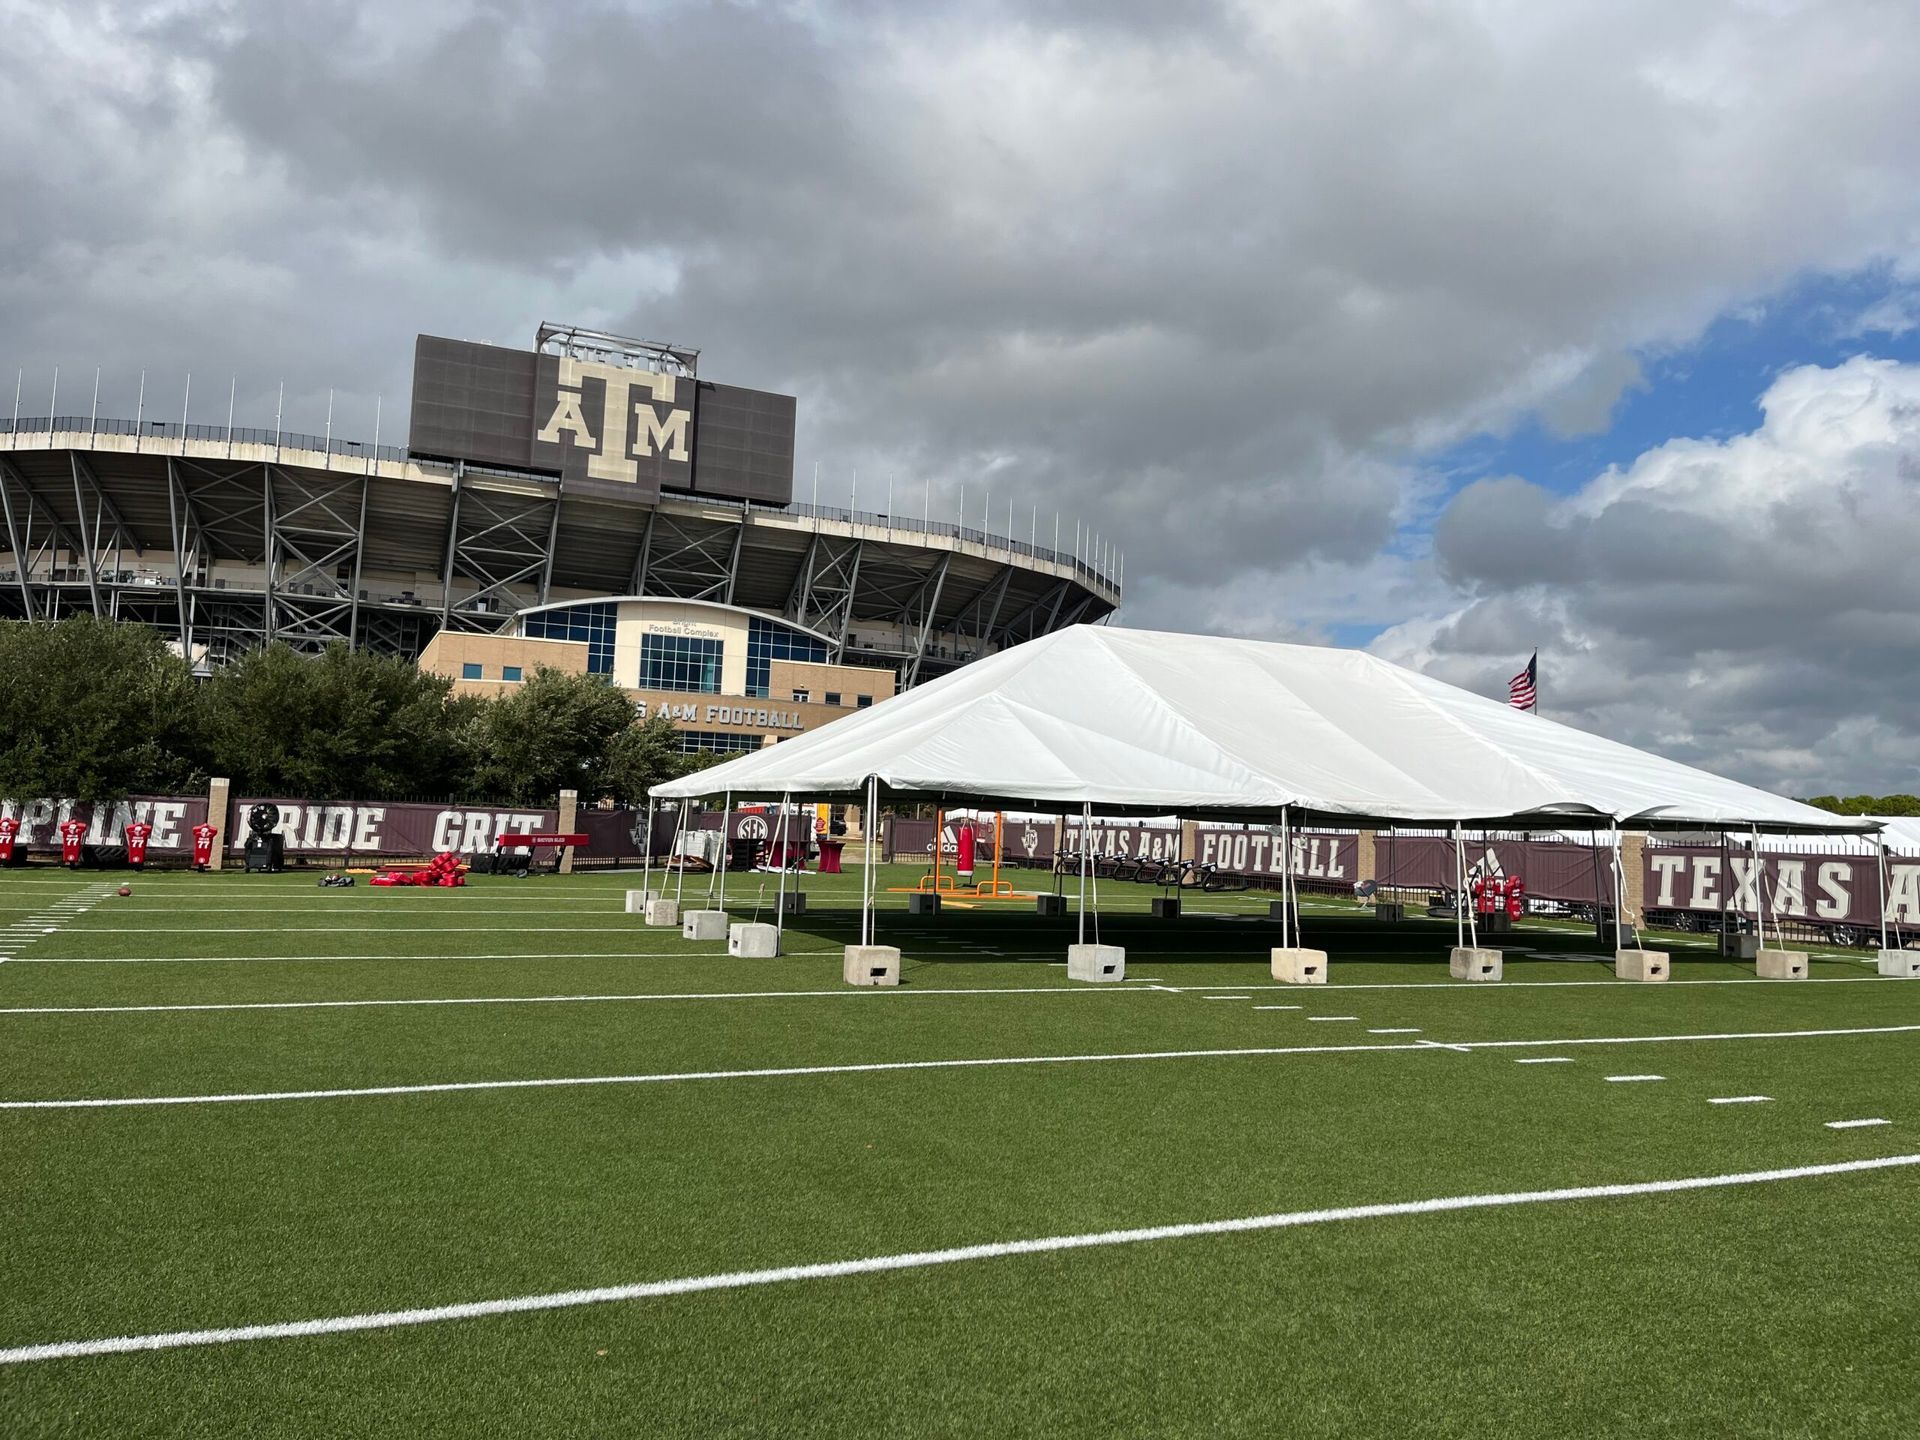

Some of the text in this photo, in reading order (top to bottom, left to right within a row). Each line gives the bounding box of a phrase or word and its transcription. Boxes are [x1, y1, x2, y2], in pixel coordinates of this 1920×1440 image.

[649, 624, 720, 637] Football Complex
[656, 701, 698, 722] A&M
[705, 704, 805, 730] FOOTBALL
[66, 837, 79, 846] 77
[431, 810, 544, 855] GRIT
[131, 839, 144, 849] 77
[197, 840, 210, 849] 77
[1138, 831, 1180, 865] A&M
[1202, 833, 1344, 878] FOOTBALL
[1651, 854, 1853, 919] TEXAS
